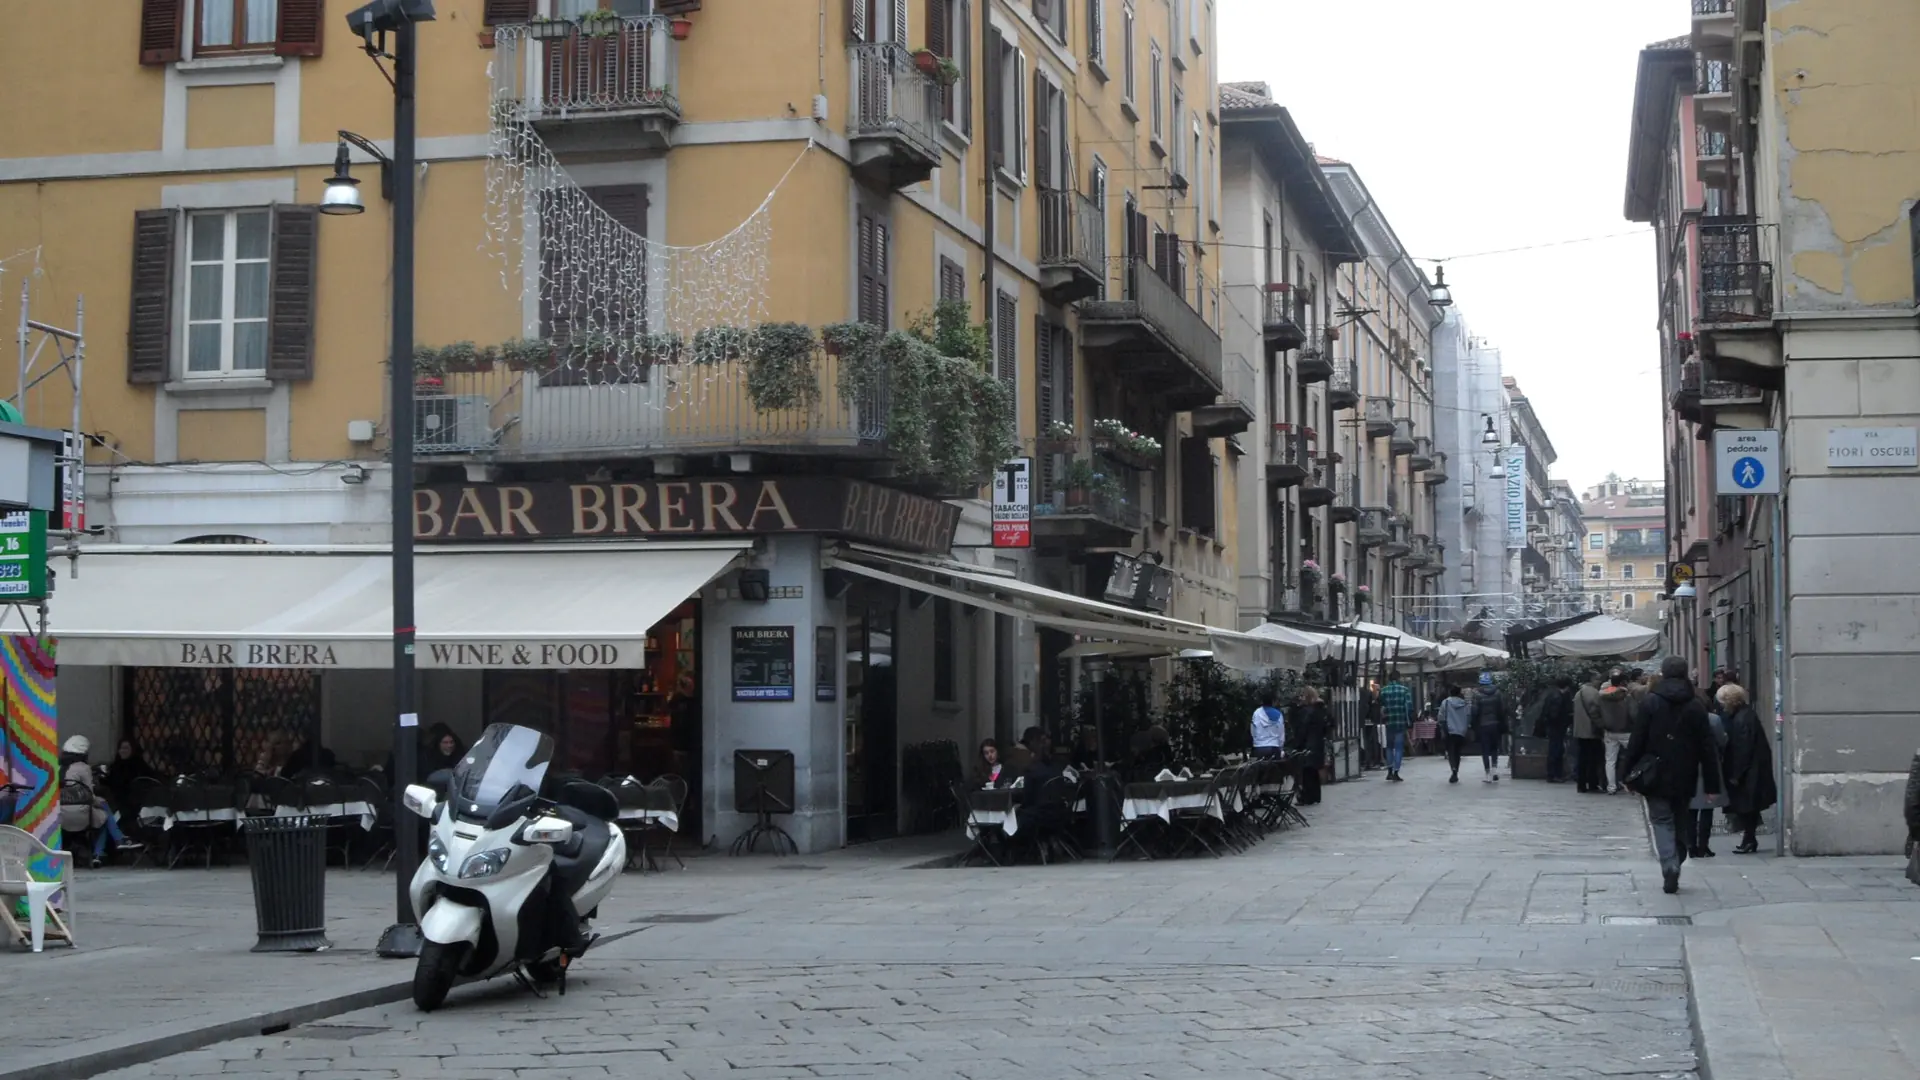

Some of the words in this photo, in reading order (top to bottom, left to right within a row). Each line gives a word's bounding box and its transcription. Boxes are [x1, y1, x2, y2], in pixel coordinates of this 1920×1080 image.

[1727, 445, 1768, 453] pedonale
[1829, 446, 1864, 457] FIORI
[1870, 446, 1916, 457] OSCURI
[998, 464, 1025, 503] T
[1507, 458, 1524, 498] SPAZIO
[413, 486, 541, 537] BAR
[570, 481, 799, 533] BRERA
[842, 482, 890, 536] BAR
[889, 493, 955, 553] BRERA
[994, 504, 1029, 512] TABACCHI
[1507, 501, 1524, 532] EDILE
[6, 537, 20, 550] 16
[736, 630, 755, 639] BAR
[757, 630, 789, 638] BRERA
[181, 643, 235, 664] BAR
[247, 644, 338, 665] BRERA
[430, 643, 503, 665] WINE
[511, 644, 532, 665] &
[540, 643, 618, 666] FOOD
